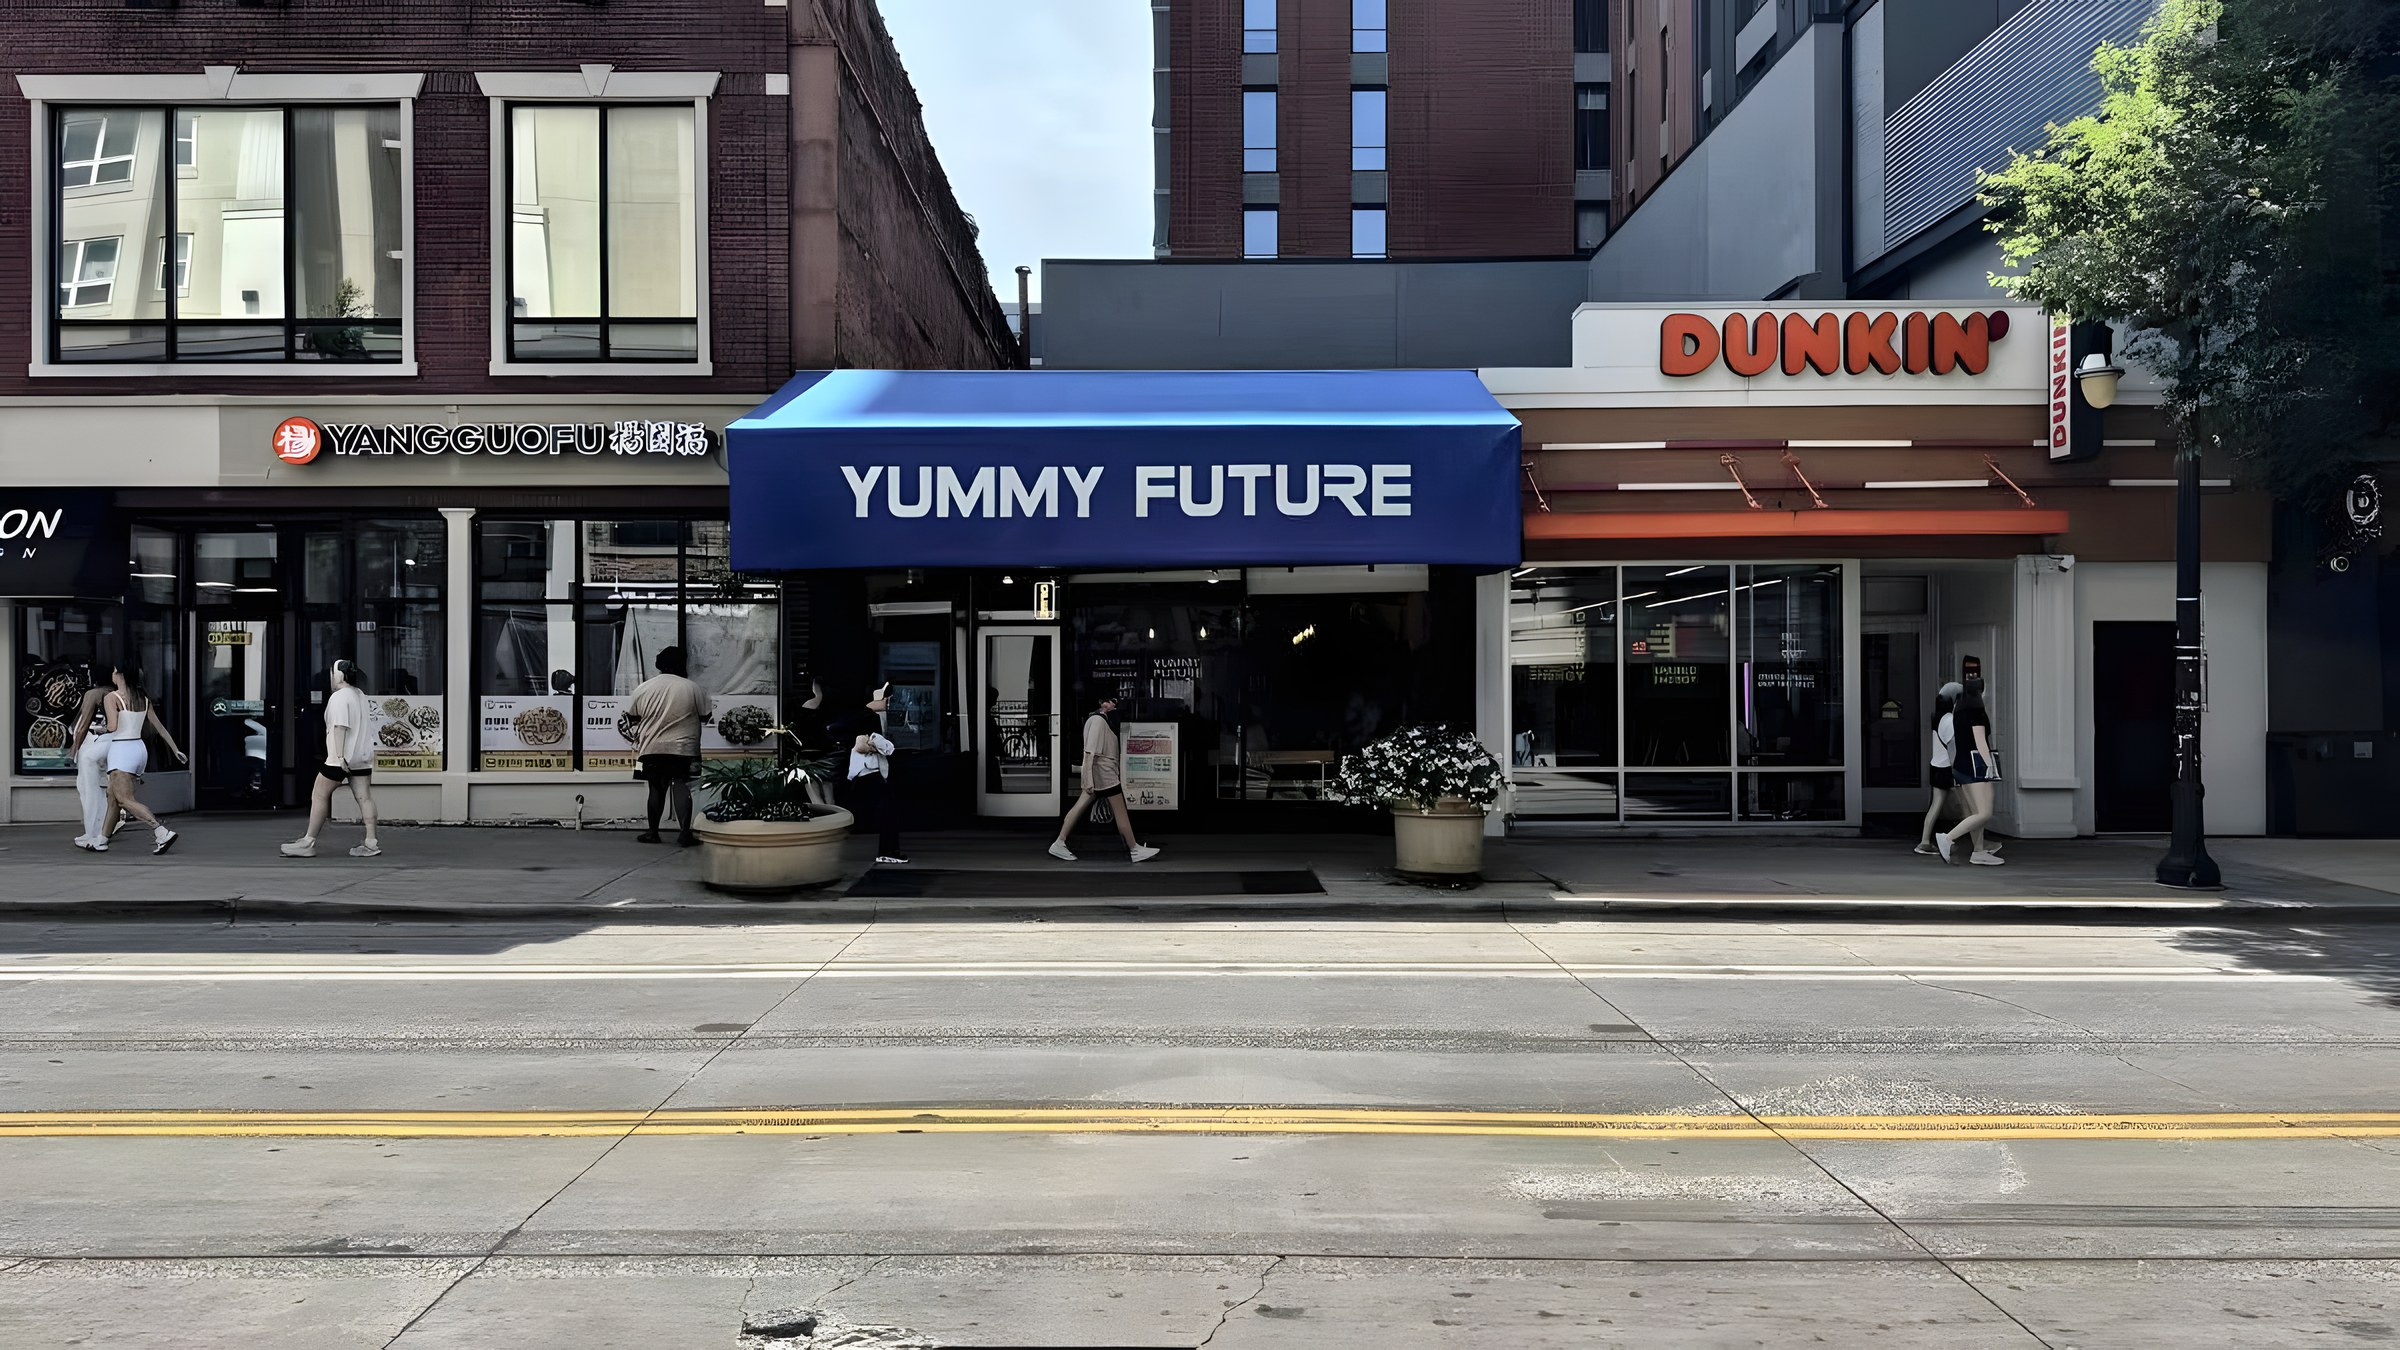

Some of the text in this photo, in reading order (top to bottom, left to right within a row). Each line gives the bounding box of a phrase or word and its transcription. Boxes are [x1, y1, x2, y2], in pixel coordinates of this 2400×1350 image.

[1660, 310, 2010, 377] DUNKIN'
[323, 423, 604, 455] YANGGUOFU
[840, 464, 1412, 518] YUMMY FUTURE
